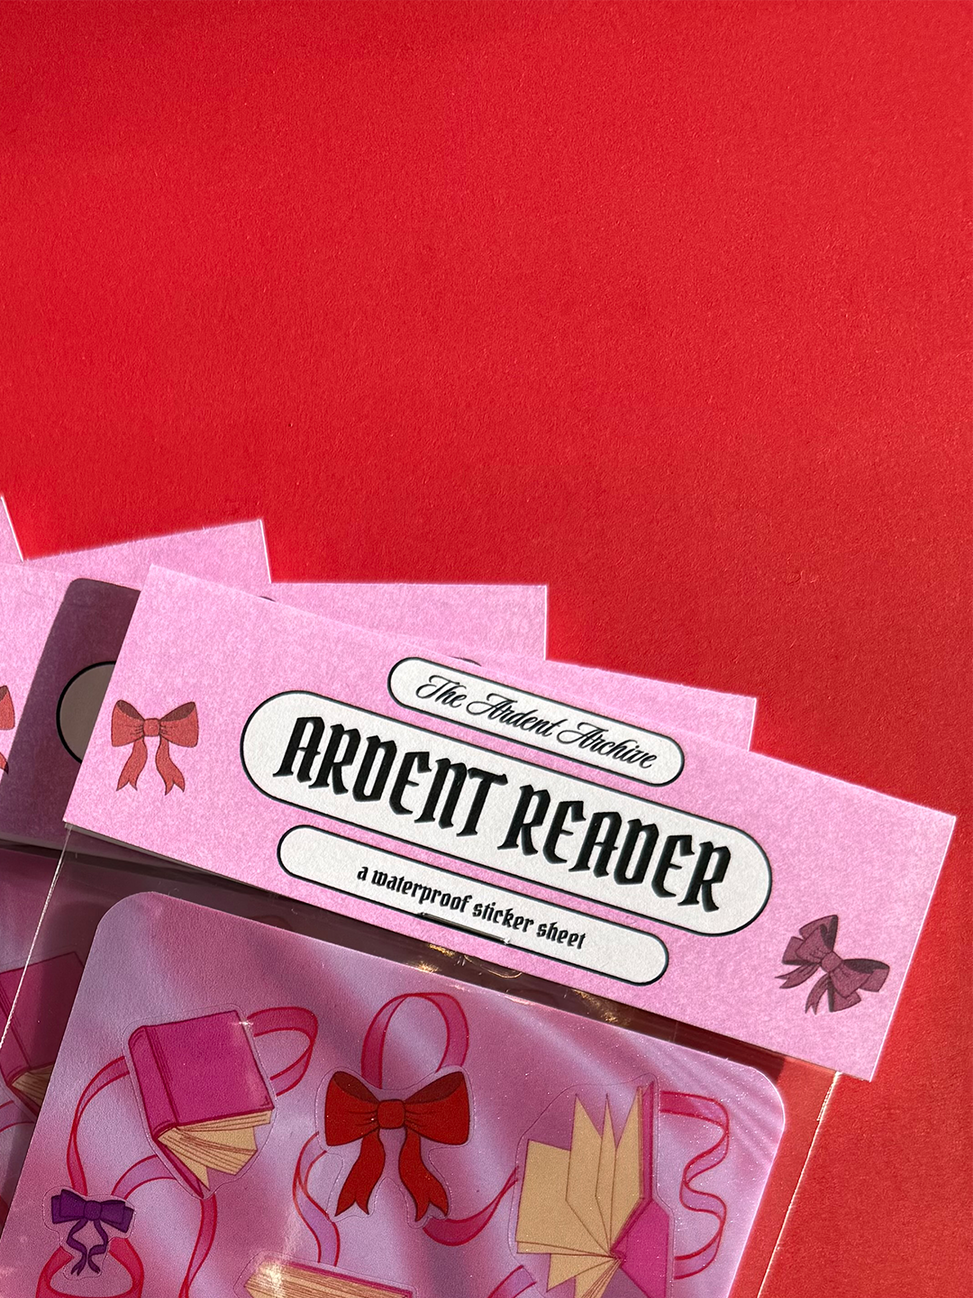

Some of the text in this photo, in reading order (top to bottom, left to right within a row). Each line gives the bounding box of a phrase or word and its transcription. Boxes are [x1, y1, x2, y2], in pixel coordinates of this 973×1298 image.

[415, 674, 658, 769] The Ardent Archive
[272, 715, 732, 913] ARDENT READER
[356, 866, 587, 950] a waterproof sticker sheet
